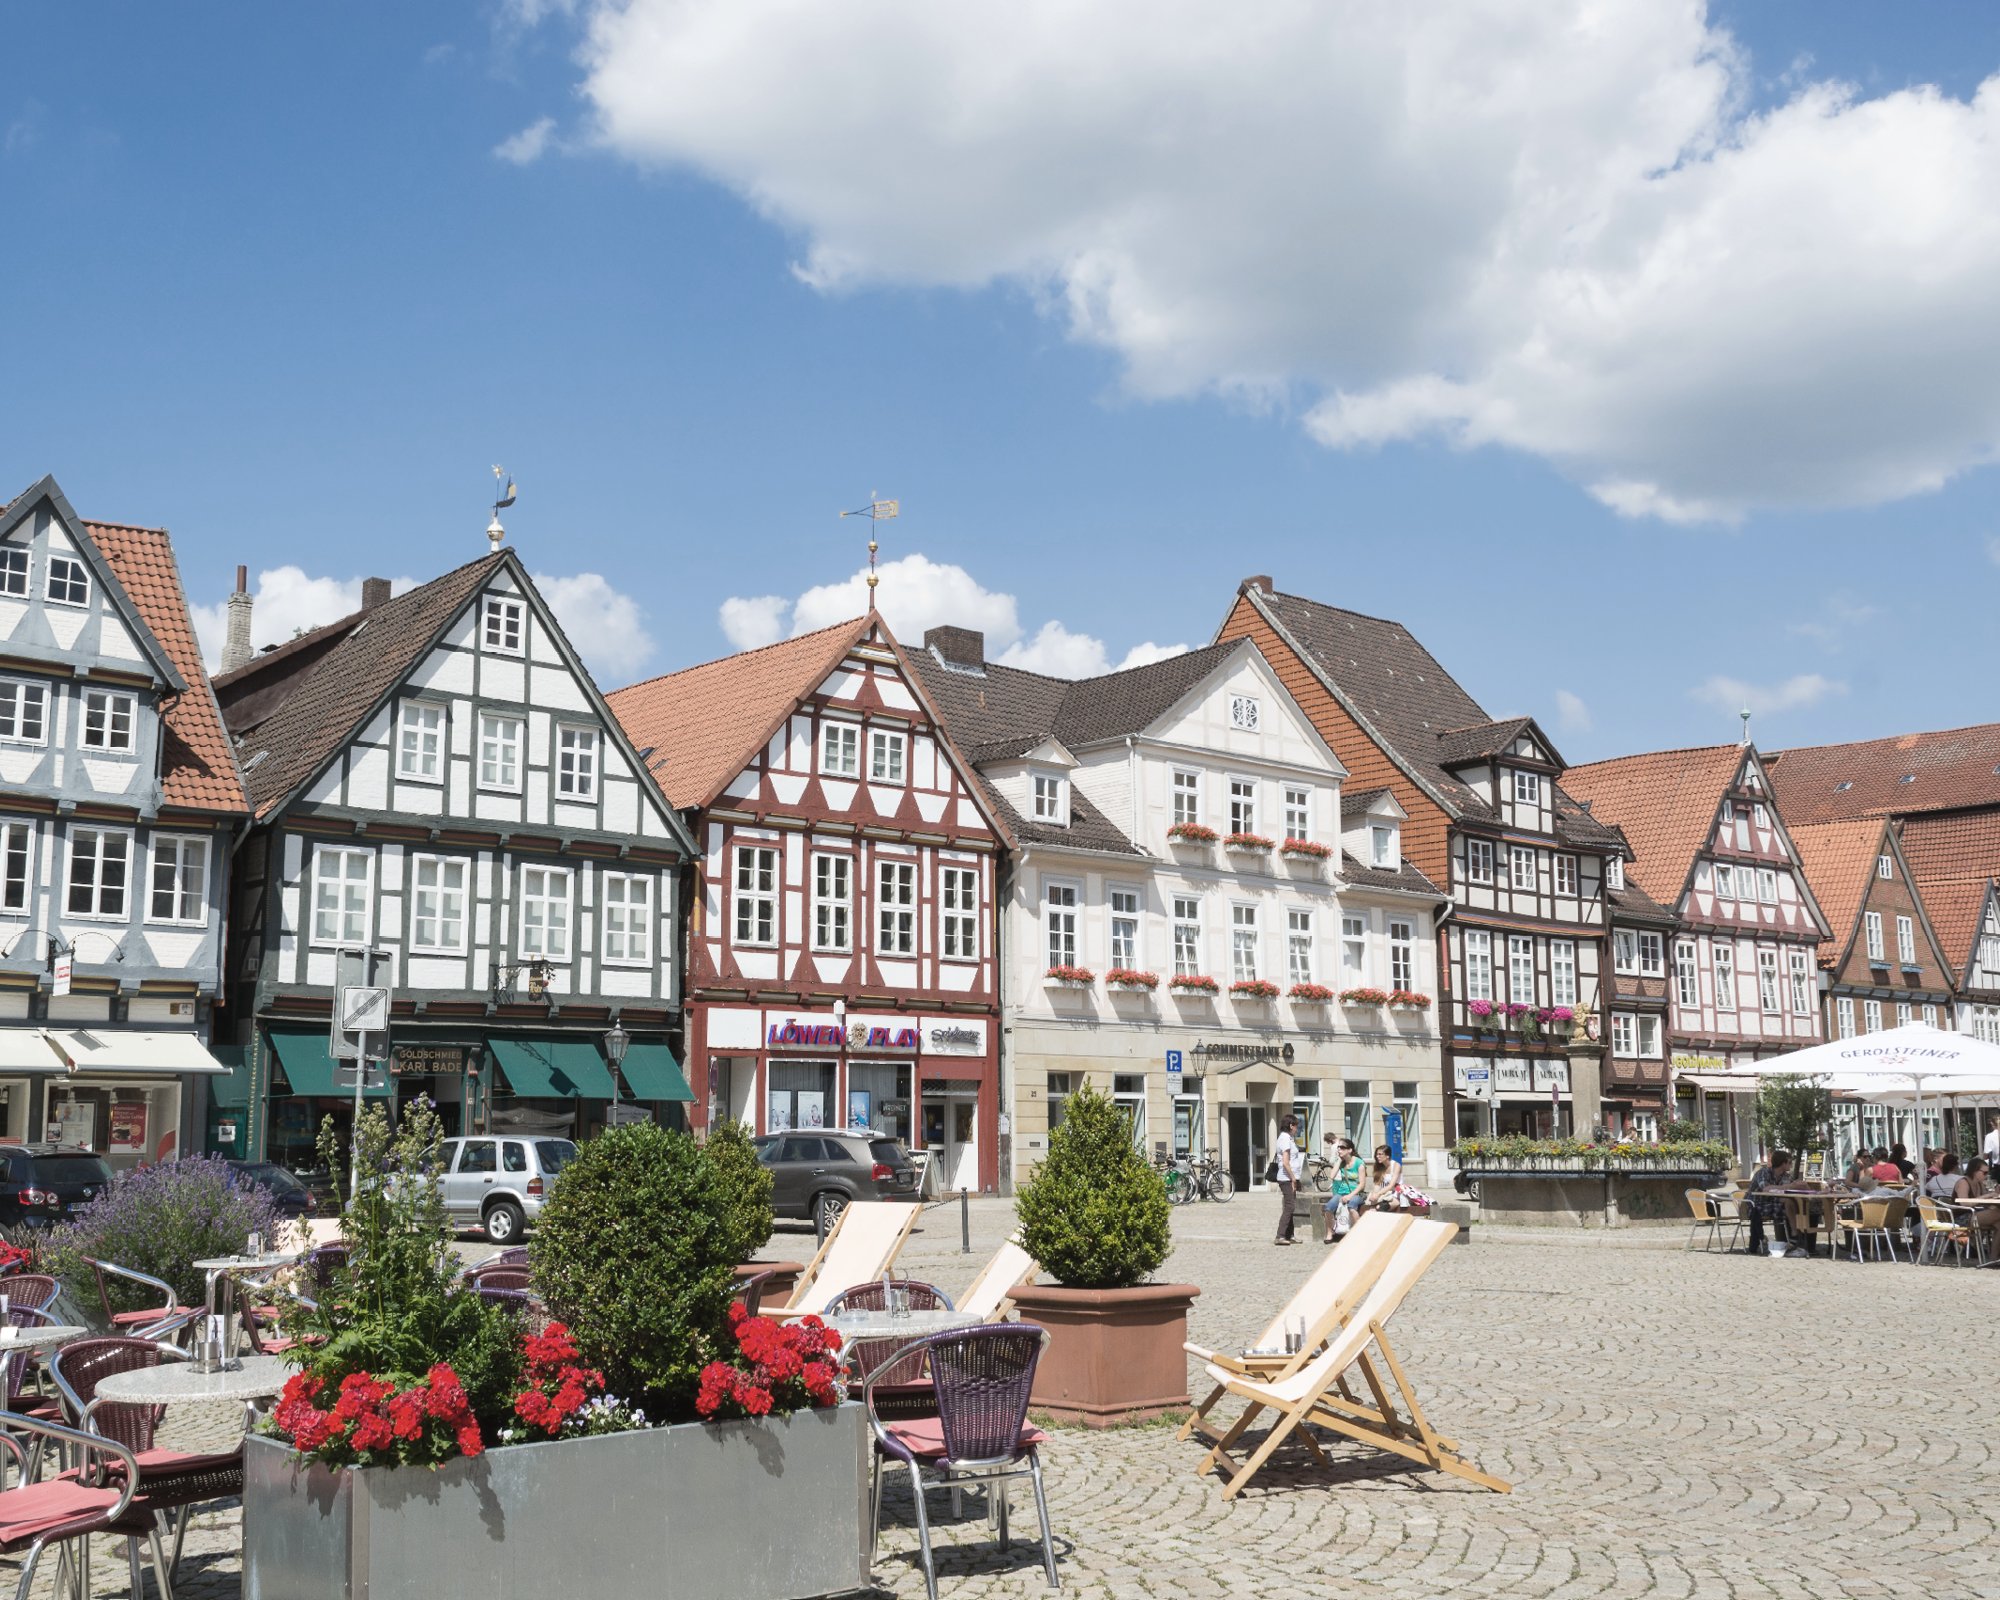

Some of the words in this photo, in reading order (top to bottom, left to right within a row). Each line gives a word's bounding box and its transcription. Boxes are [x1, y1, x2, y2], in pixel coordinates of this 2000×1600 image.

[768, 1018, 848, 1045] LÖWEN
[869, 1027, 922, 1048] PLAY
[400, 1050, 463, 1059] GOLDSCHMIED
[1207, 1043, 1280, 1058] COMMERZBANK
[1840, 1046, 1961, 1060] GEROLSTEINER
[400, 1061, 429, 1072] KARL
[432, 1062, 462, 1072] BADE
[1169, 1053, 1179, 1070] P
